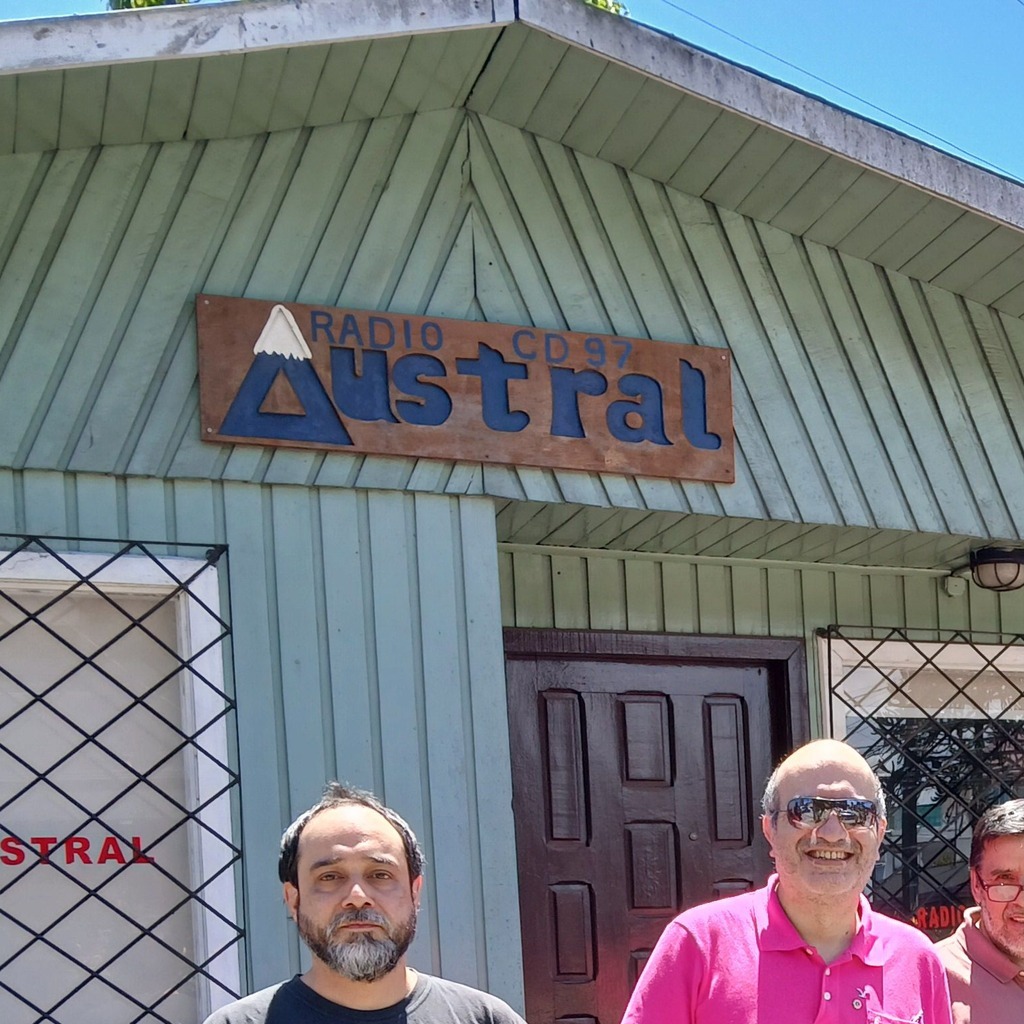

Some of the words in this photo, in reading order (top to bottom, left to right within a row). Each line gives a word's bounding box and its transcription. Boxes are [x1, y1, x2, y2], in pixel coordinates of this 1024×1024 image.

[310, 309, 444, 351] RADIO
[511, 329, 570, 364] CD
[584, 340, 634, 369] 97
[216, 304, 722, 450] Austral
[0, 836, 155, 866] STRAL
